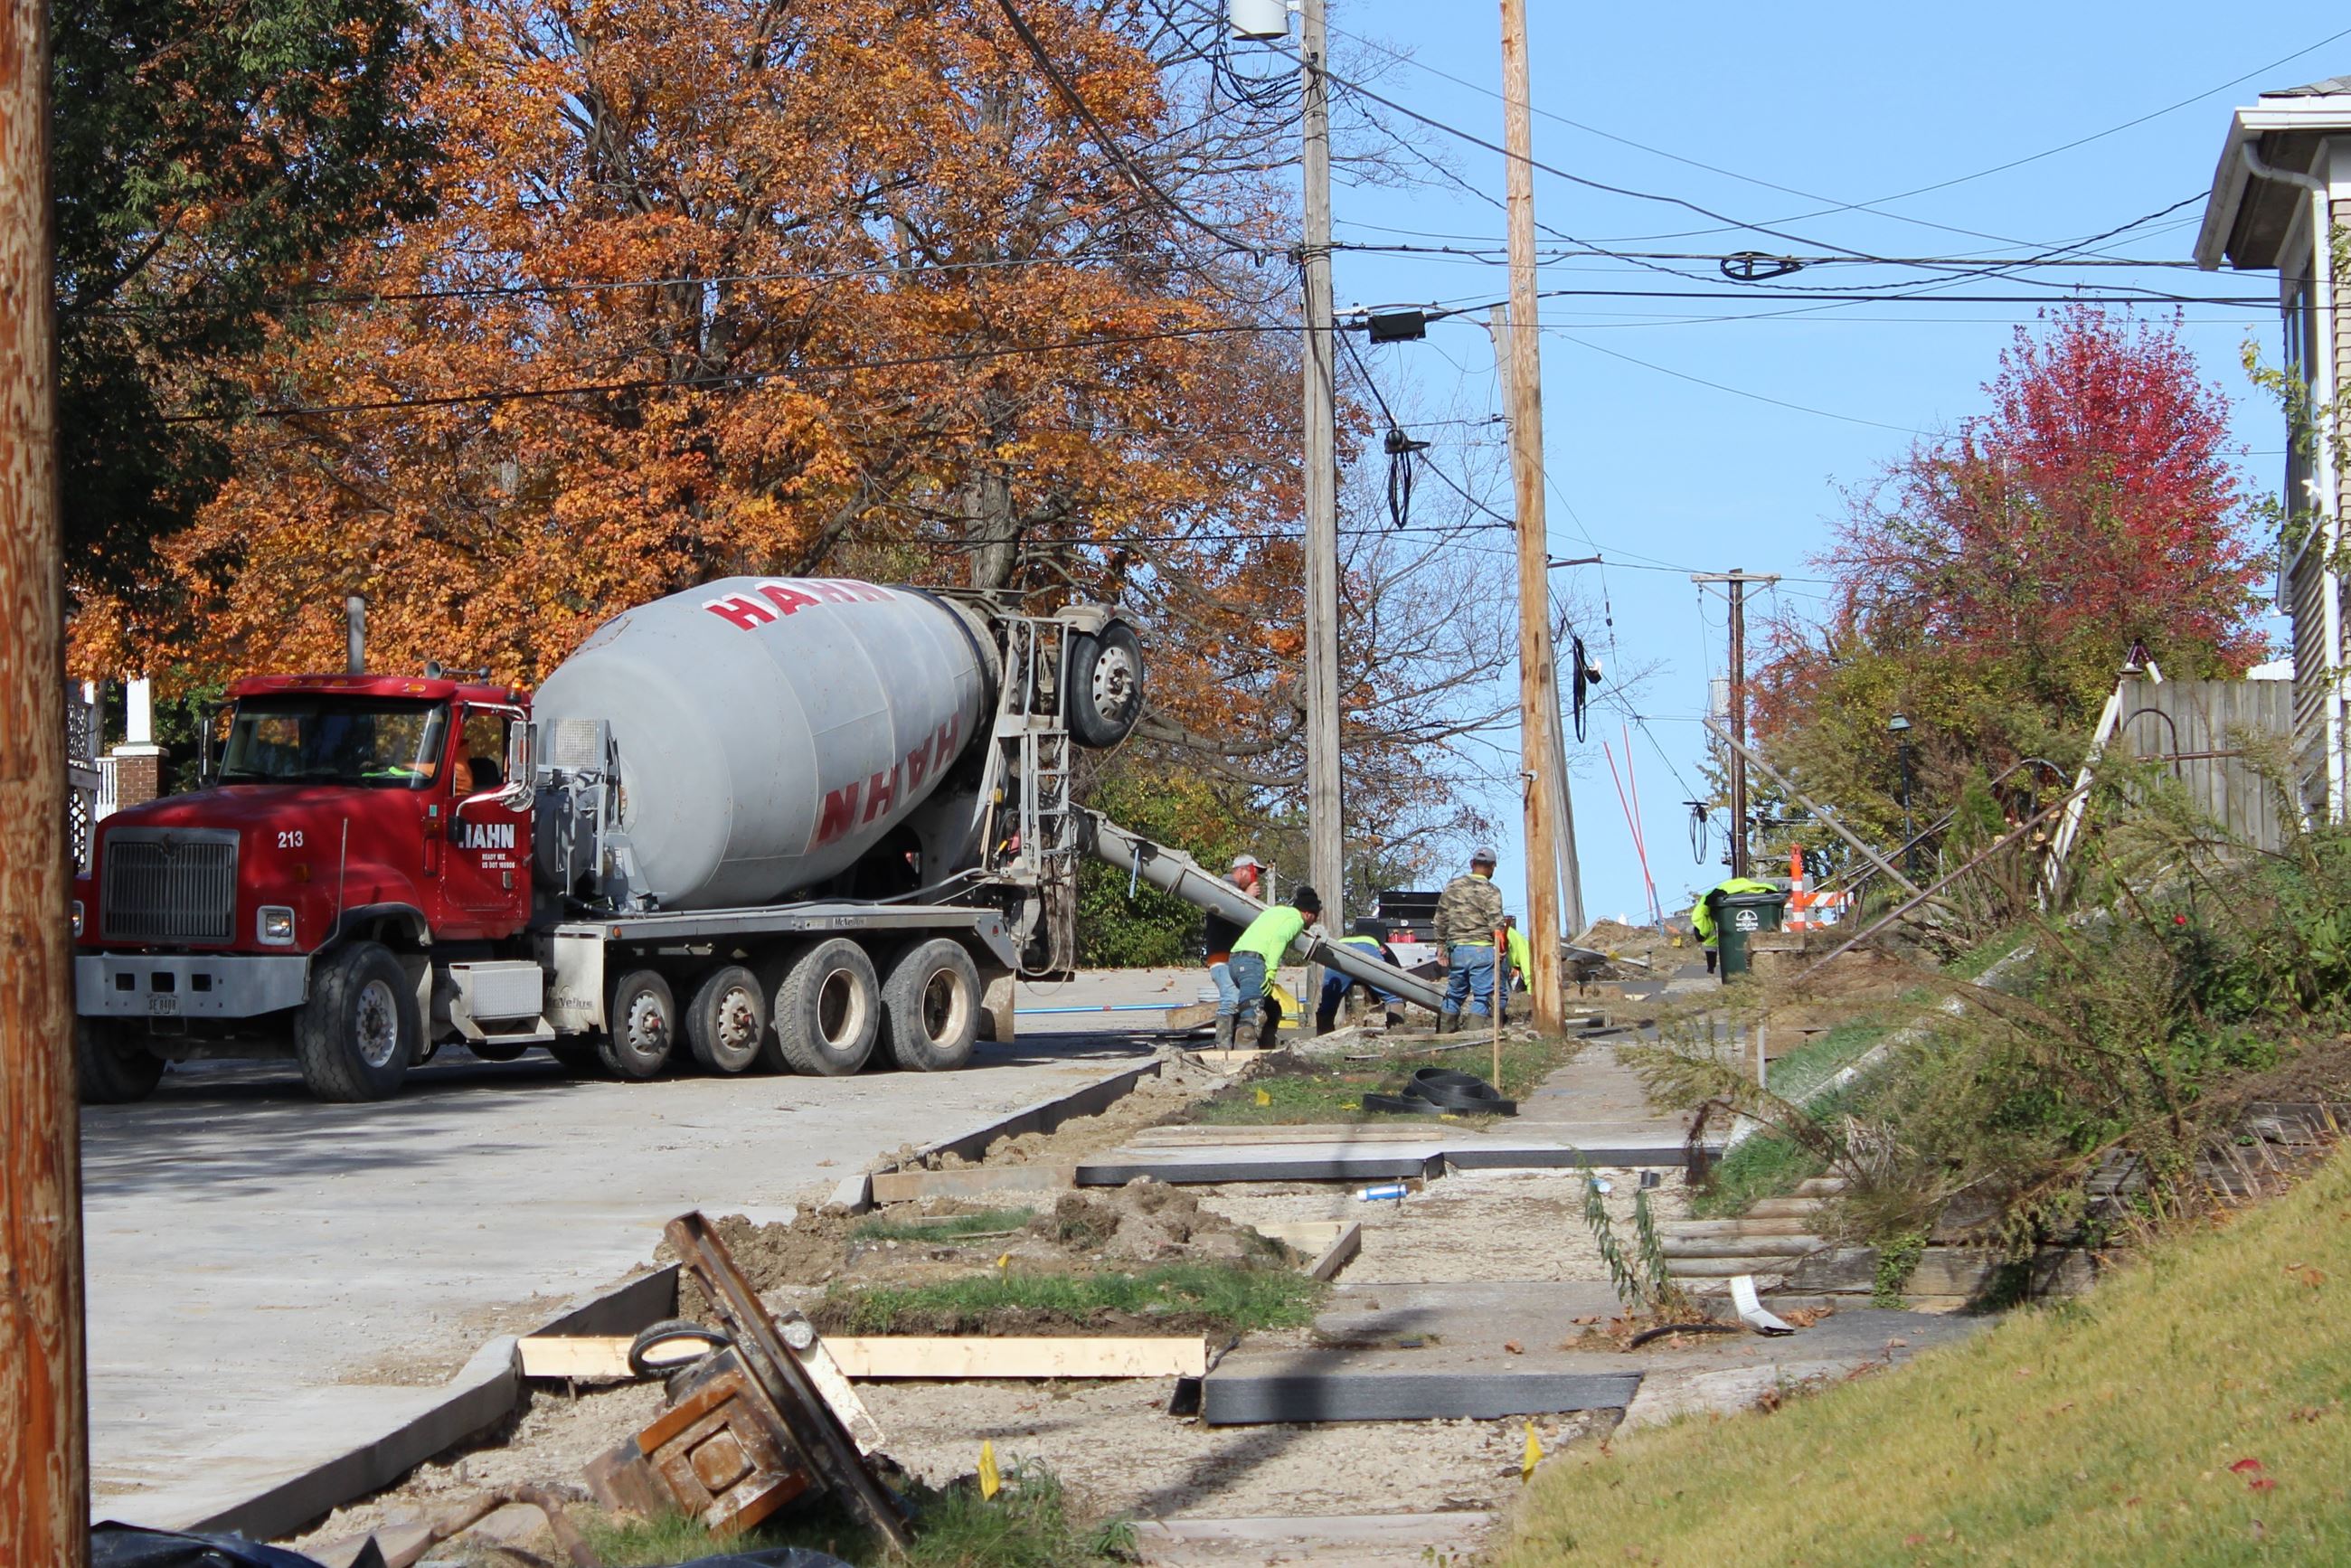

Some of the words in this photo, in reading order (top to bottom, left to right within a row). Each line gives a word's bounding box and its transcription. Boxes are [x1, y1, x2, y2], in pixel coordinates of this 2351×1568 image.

[702, 580, 897, 631] HAHN
[814, 710, 959, 846] HAHN
[278, 830, 304, 848] 213
